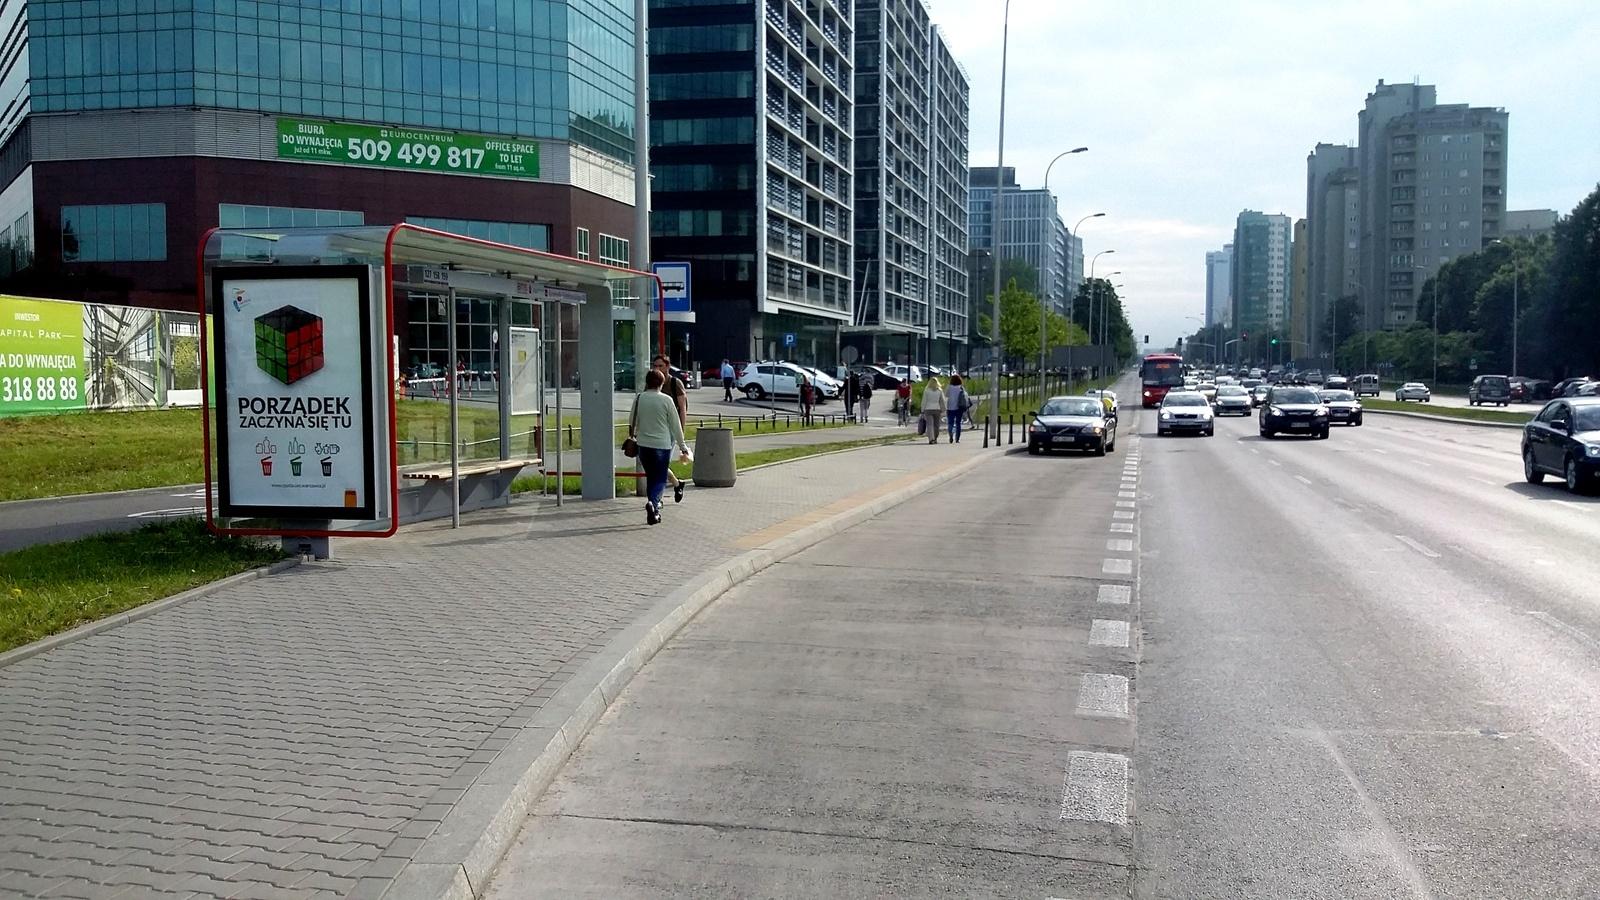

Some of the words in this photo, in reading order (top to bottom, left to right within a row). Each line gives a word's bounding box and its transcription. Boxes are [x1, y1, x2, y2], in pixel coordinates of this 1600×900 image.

[298, 124, 325, 135] BIURA
[389, 131, 454, 143] EUROCENTRUM
[282, 134, 295, 144] DO
[296, 135, 343, 149] WYNAJĘCIA
[485, 141, 510, 152] OFFICE
[511, 144, 534, 154] SPACE
[311, 147, 318, 155] 11
[347, 138, 392, 161] 509
[397, 143, 441, 166] 499
[447, 146, 485, 169] 817
[499, 153, 509, 163] TO
[510, 154, 522, 164] LET
[8, 353, 24, 368] DO
[25, 354, 77, 372] WYNAJĘCIA
[2, 377, 33, 402] 318
[36, 377, 56, 401] 88
[60, 377, 78, 401] 88
[238, 397, 351, 418] PORZĄDEK
[239, 416, 305, 428] ZACZYNA
[307, 416, 329, 431] SIĘ
[331, 416, 352, 428] TU
